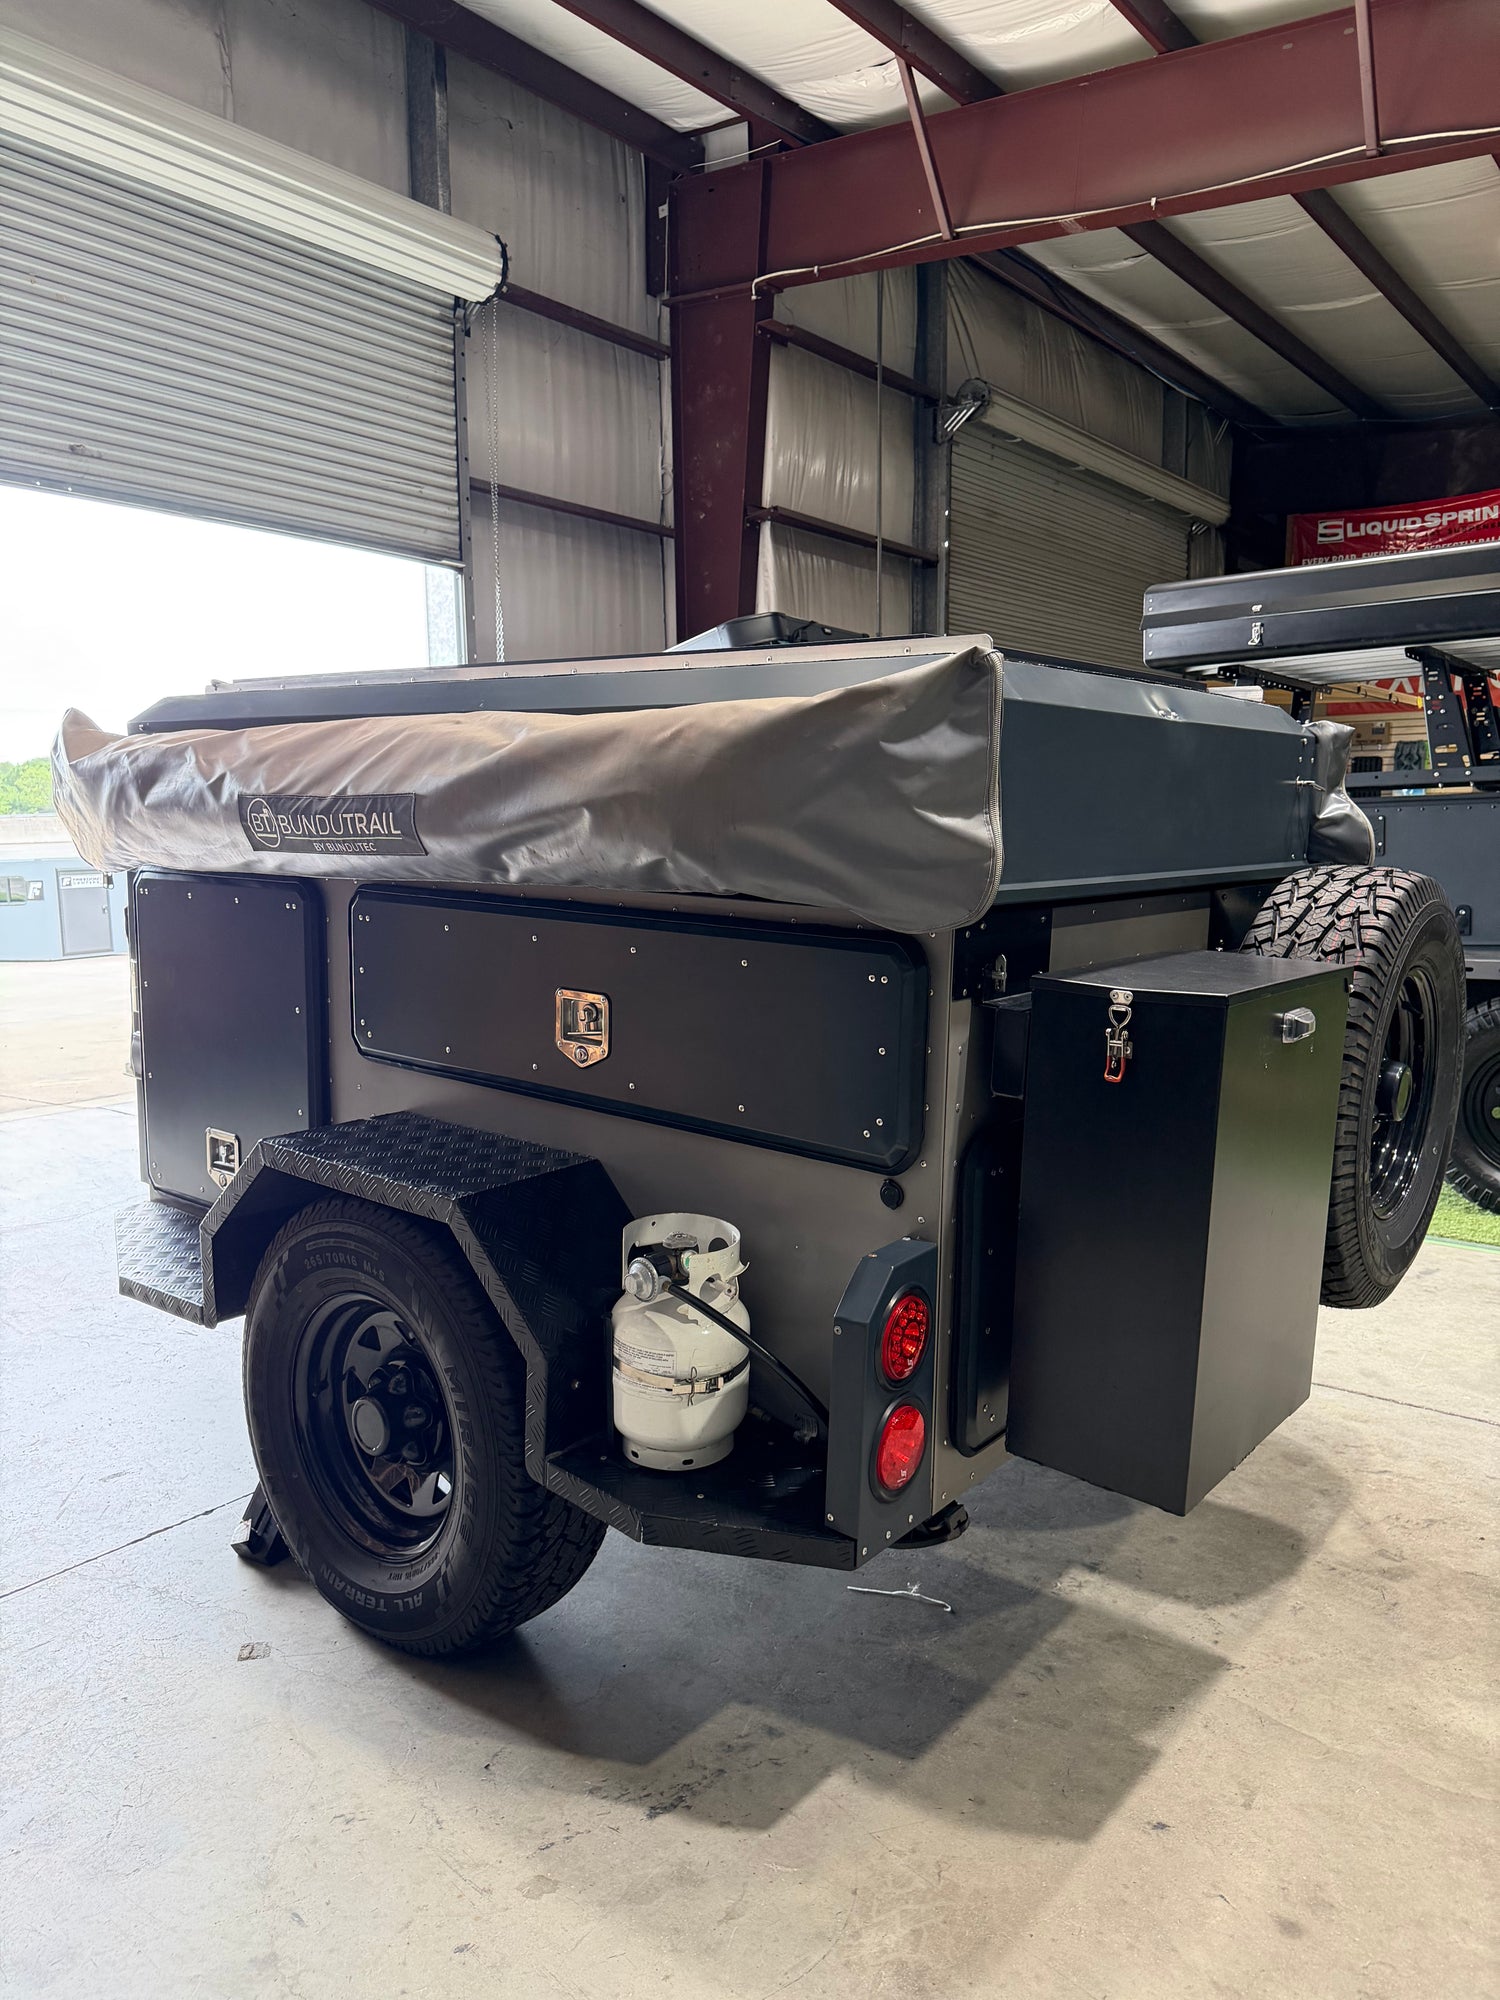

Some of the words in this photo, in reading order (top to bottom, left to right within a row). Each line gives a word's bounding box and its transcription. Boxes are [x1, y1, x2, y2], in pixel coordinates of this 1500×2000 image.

[1346, 505, 1500, 538] LIQUIDSPRIN
[278, 812, 402, 835] BUNDUTRAIL
[314, 842, 325, 851] BY
[327, 842, 377, 852] BUNDUTEC
[304, 1252, 359, 1270] 265/70R16
[444, 1364, 478, 1547] MIRAGE
[320, 1562, 388, 1613] TERRAIN
[393, 1591, 424, 1613] ALL
